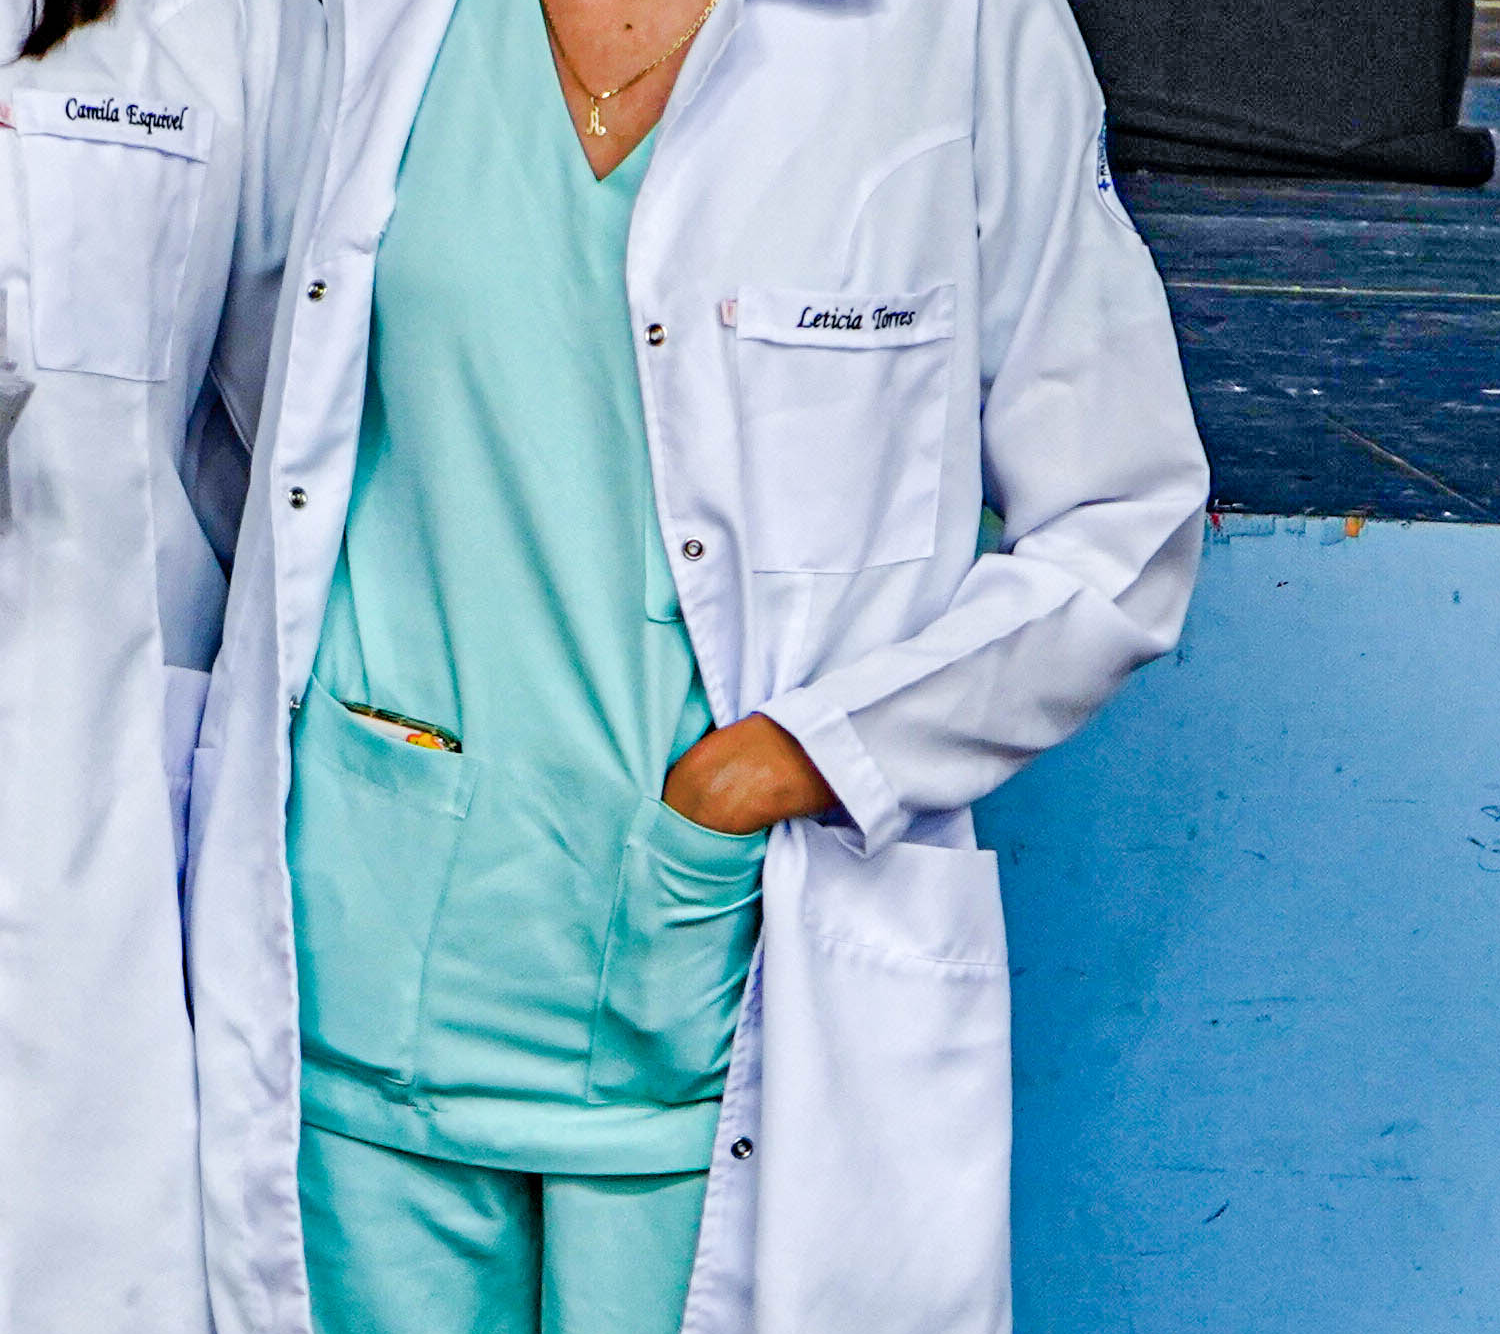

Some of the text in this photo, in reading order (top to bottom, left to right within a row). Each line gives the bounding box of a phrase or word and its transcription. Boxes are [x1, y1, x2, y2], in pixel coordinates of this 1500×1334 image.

[65, 97, 189, 135] Camila Esquivel
[796, 305, 916, 330] Leticia Torres
